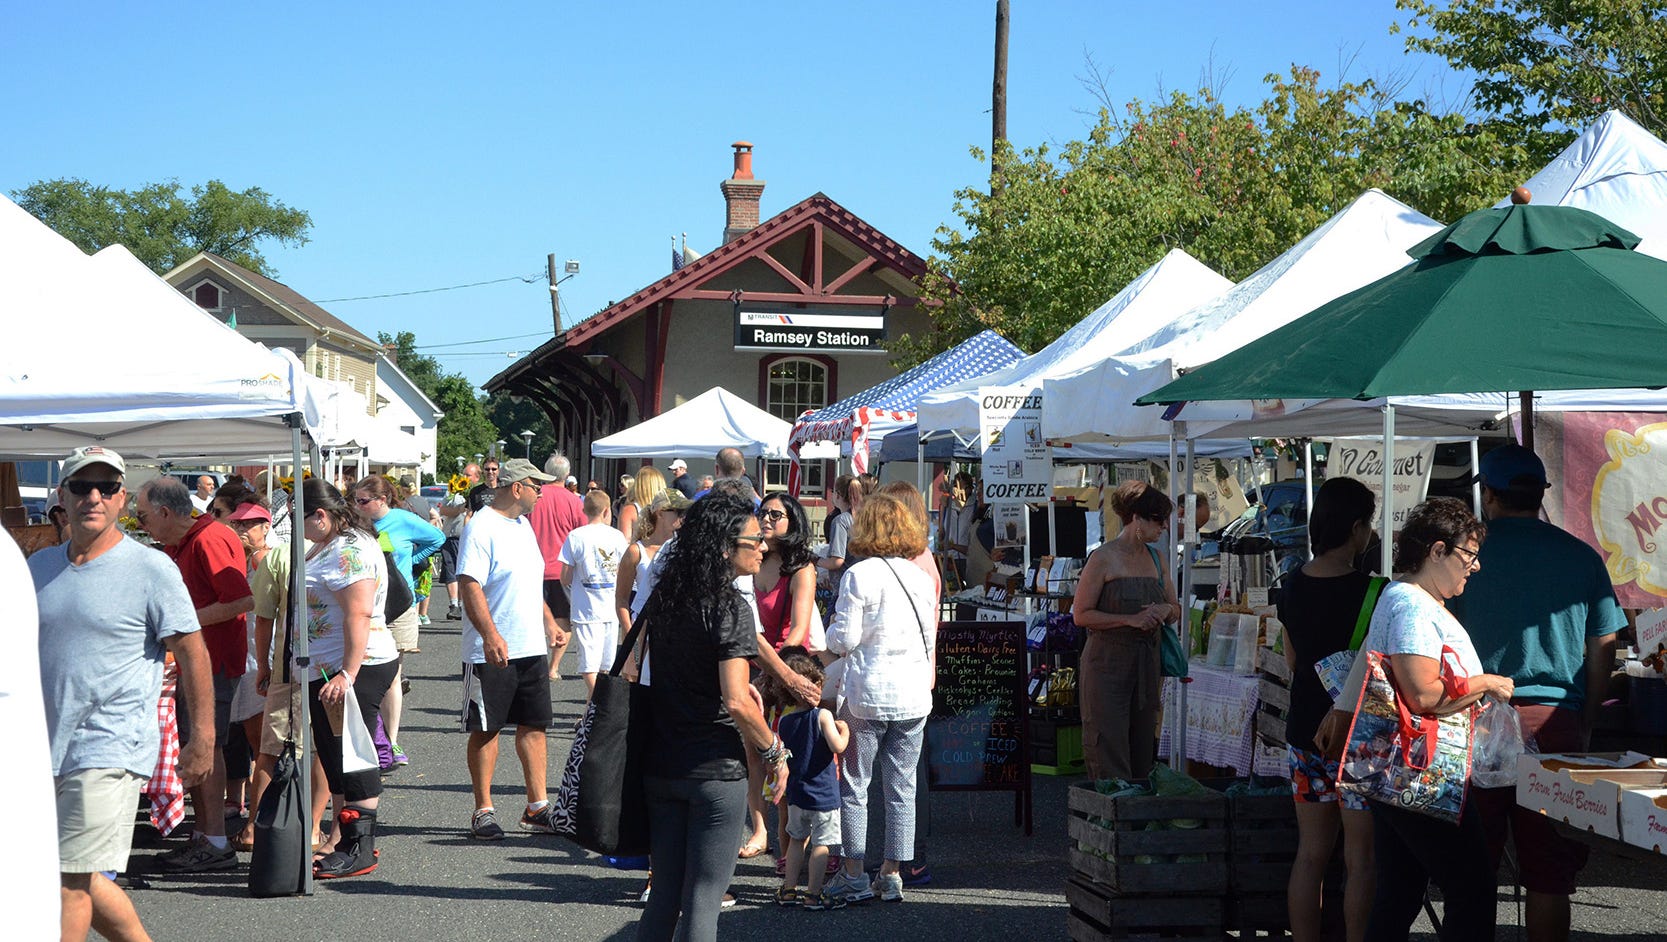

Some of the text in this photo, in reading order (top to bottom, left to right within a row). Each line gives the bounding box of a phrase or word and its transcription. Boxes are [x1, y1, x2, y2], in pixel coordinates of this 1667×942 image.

[754, 329, 869, 347] Ramsey Station
[983, 395, 1043, 410] COFFEE
[1356, 449, 1424, 476] Goumet
[985, 483, 1048, 498] COFFEE
[1002, 641, 1017, 654] Free
[991, 655, 1016, 665] Scones
[951, 665, 977, 675] Cakes
[946, 695, 1013, 708] Bread Pudding
[948, 721, 1007, 736] COFFEE
[987, 737, 1017, 751] ICED
[942, 750, 973, 763] COLD
[1529, 773, 1608, 816] Farm Fresh Berries
